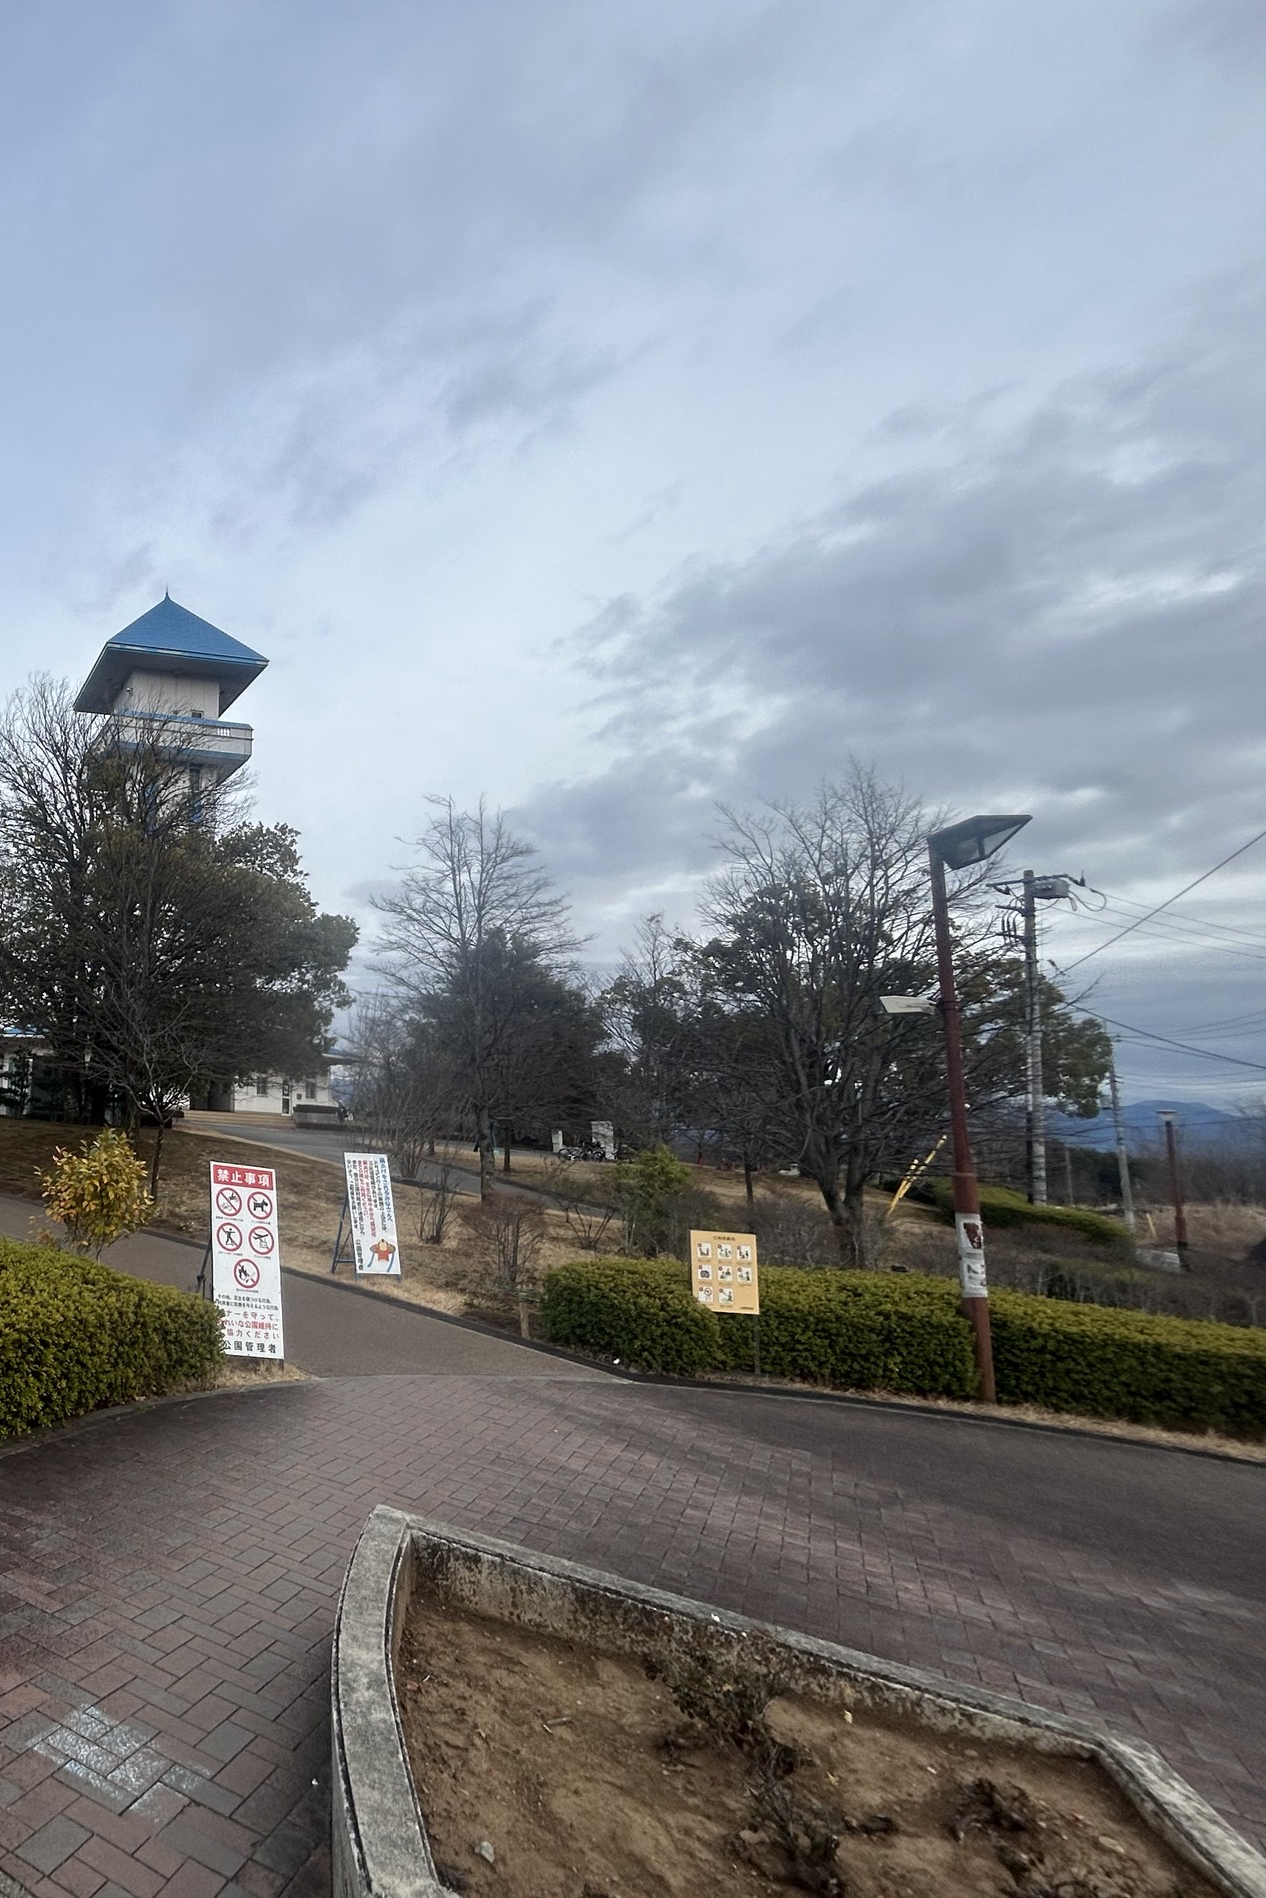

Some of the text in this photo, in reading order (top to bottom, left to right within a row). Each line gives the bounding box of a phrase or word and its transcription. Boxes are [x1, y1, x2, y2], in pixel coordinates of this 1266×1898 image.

[217, 1168, 271, 1187] 禁止事項
[223, 1310, 279, 1321] ナーを守って、
[222, 1319, 279, 1330] れいな公園維持に
[226, 1328, 280, 1340] 協力ください
[223, 1340, 276, 1354] 公園管理者
